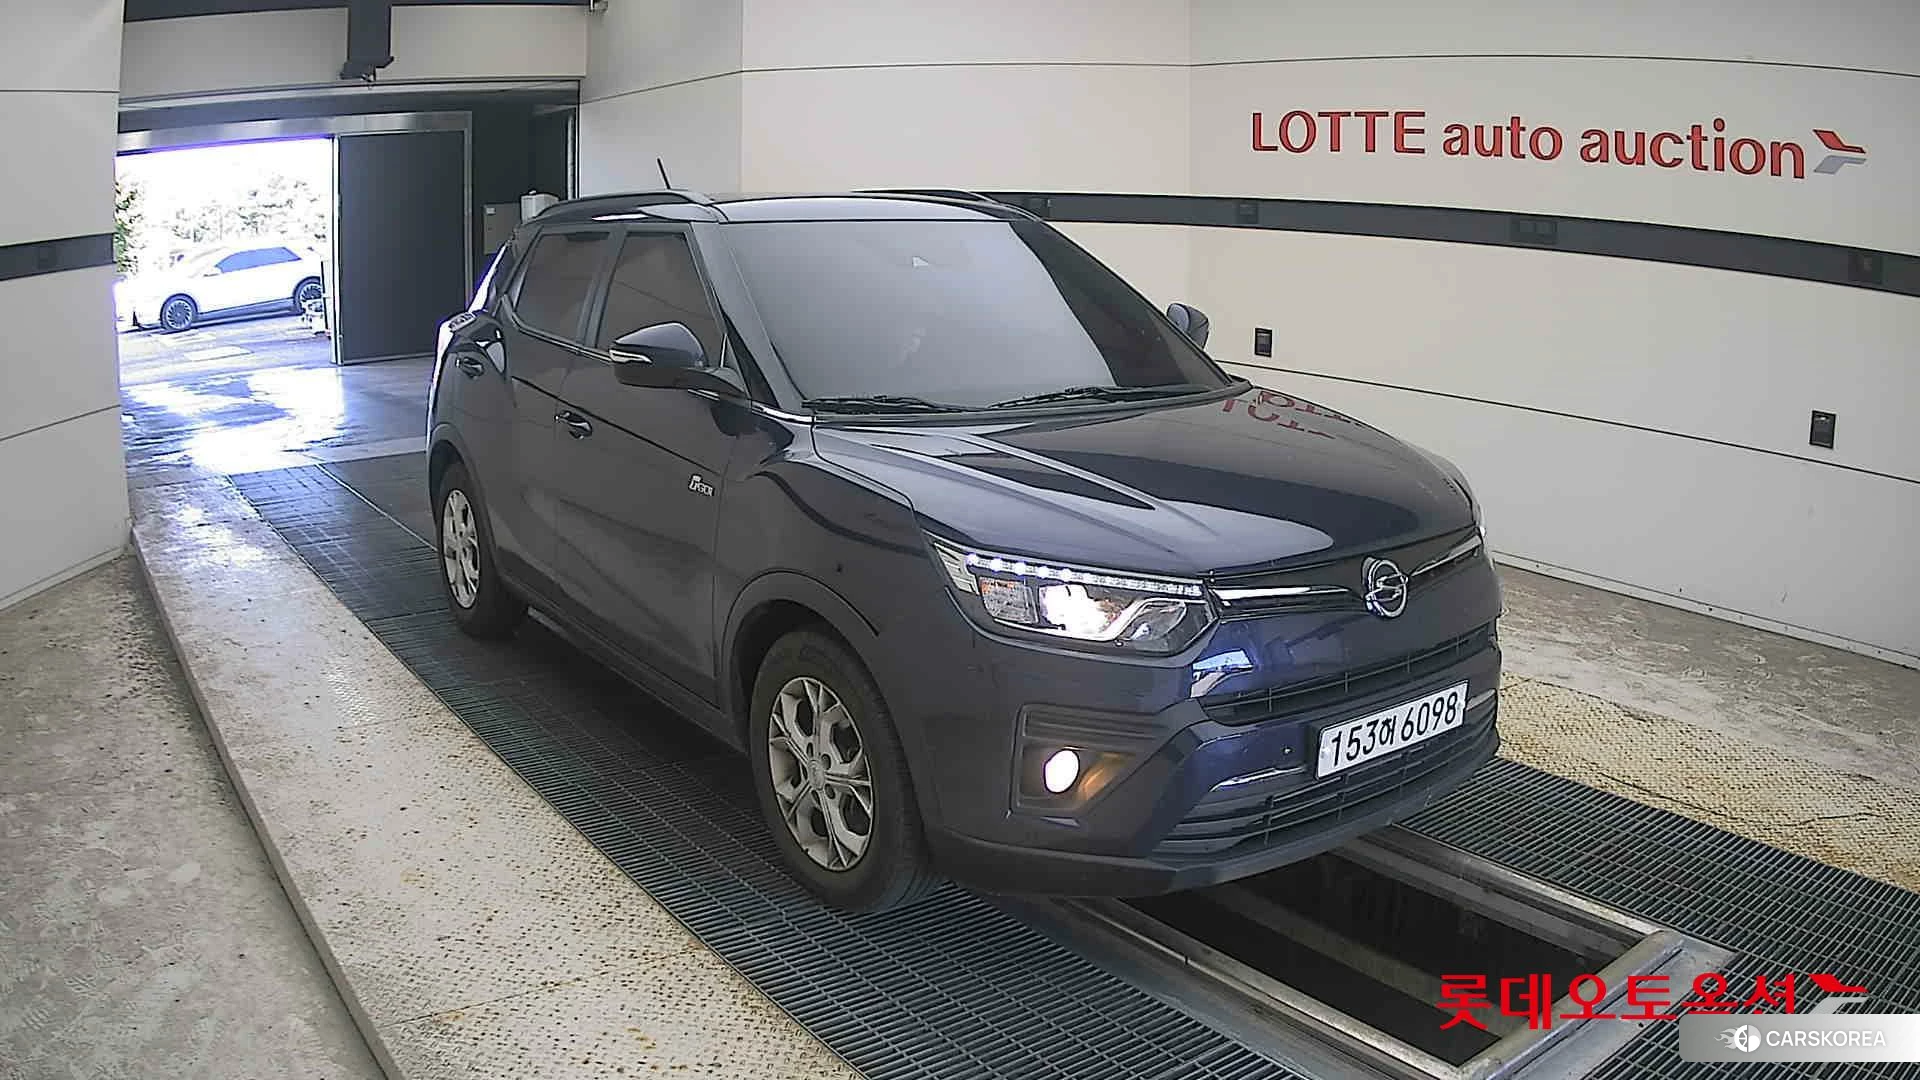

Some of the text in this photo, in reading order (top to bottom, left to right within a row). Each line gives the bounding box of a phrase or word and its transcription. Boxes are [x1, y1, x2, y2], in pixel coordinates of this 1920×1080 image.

[1251, 110, 1806, 180] LOTTE auto auction
